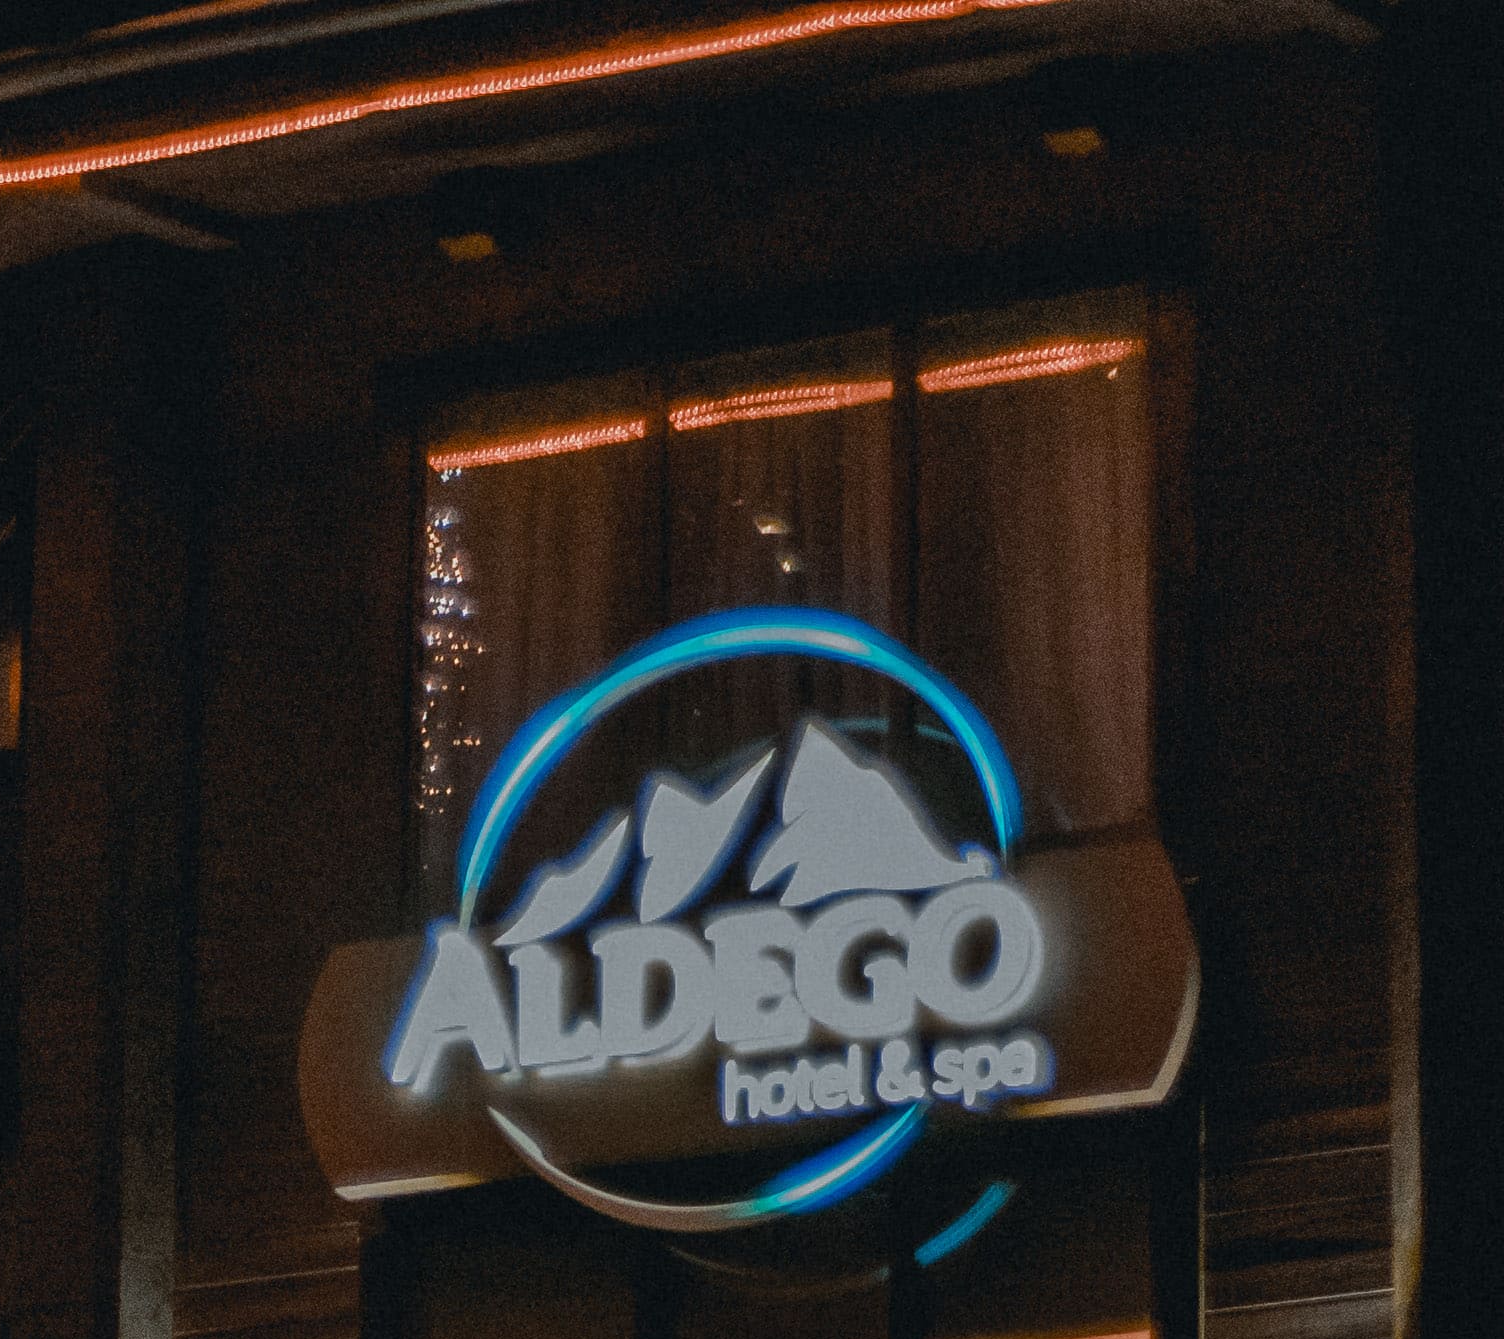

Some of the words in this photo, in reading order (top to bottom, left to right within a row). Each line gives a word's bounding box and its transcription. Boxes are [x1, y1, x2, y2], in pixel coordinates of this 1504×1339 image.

[390, 880, 1042, 1092] ALDEGO
[723, 1043, 865, 1122] hotel
[875, 1038, 926, 1102] &
[931, 1038, 1037, 1106] spa
